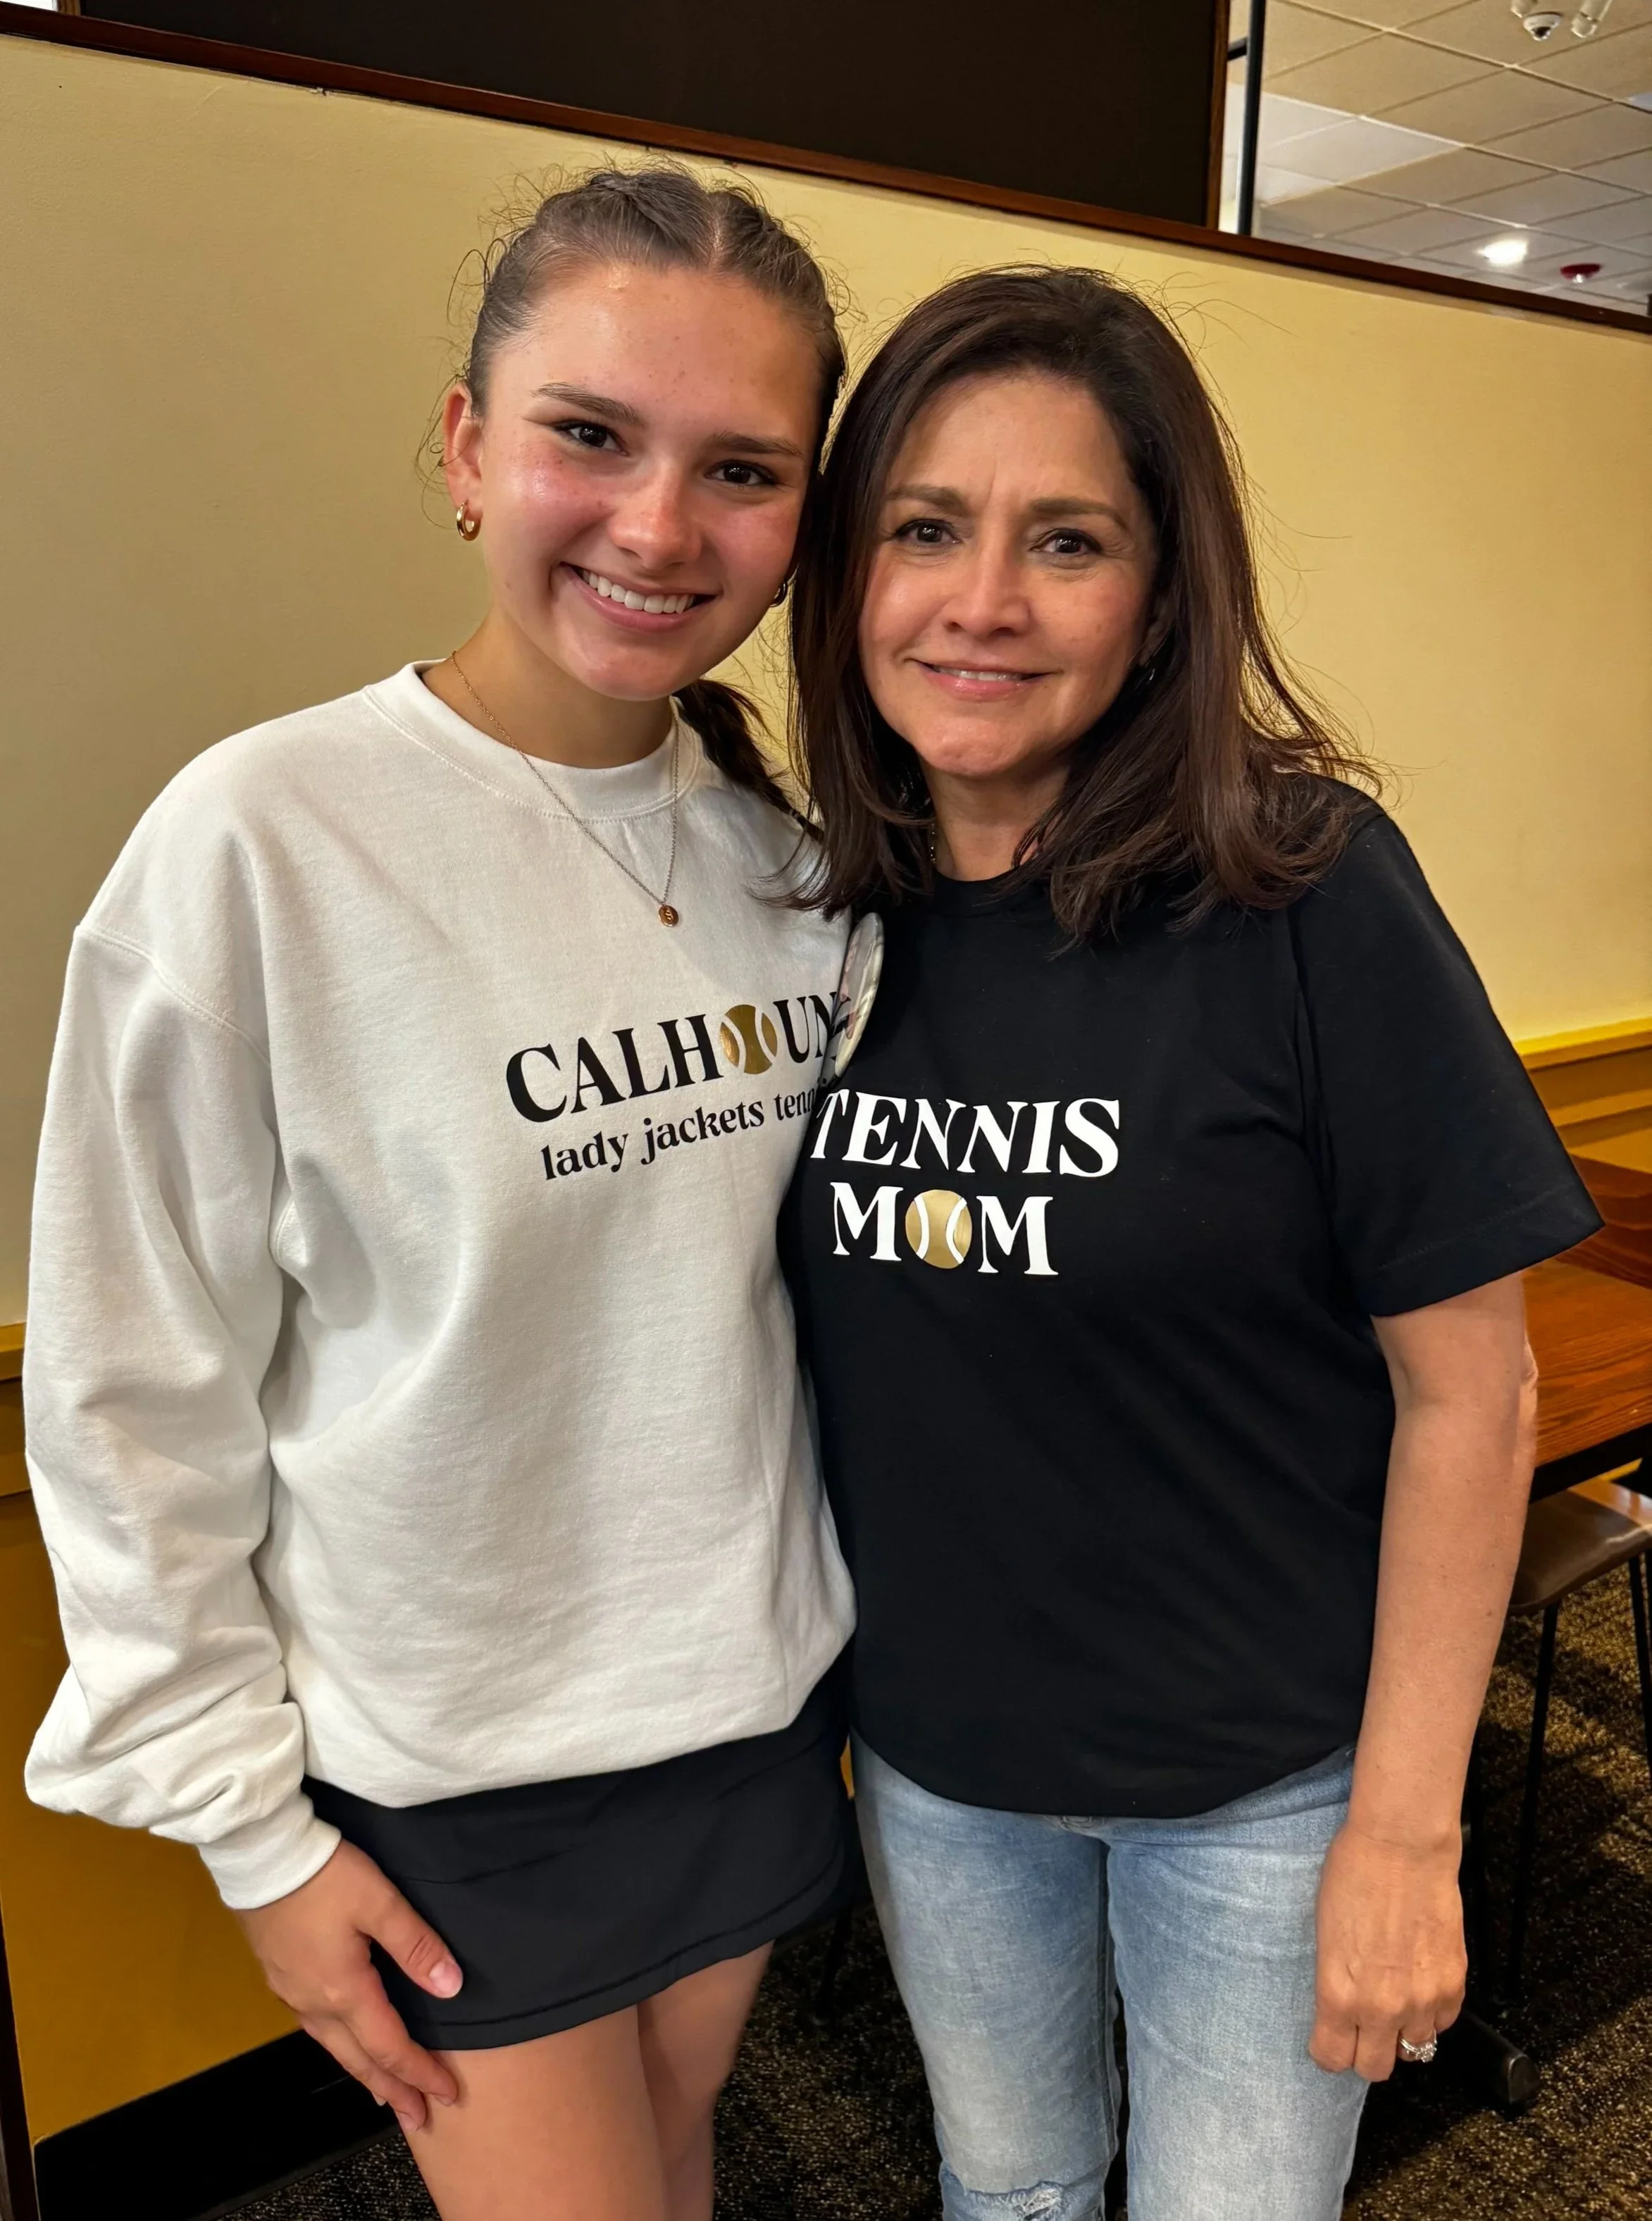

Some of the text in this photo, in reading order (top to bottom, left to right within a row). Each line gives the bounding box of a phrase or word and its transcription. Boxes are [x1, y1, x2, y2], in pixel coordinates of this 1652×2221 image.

[540, 1078, 819, 1181] lady jackets tenn
[810, 1089, 1119, 1178] TENNIS
[830, 1181, 1058, 1276] MOM
